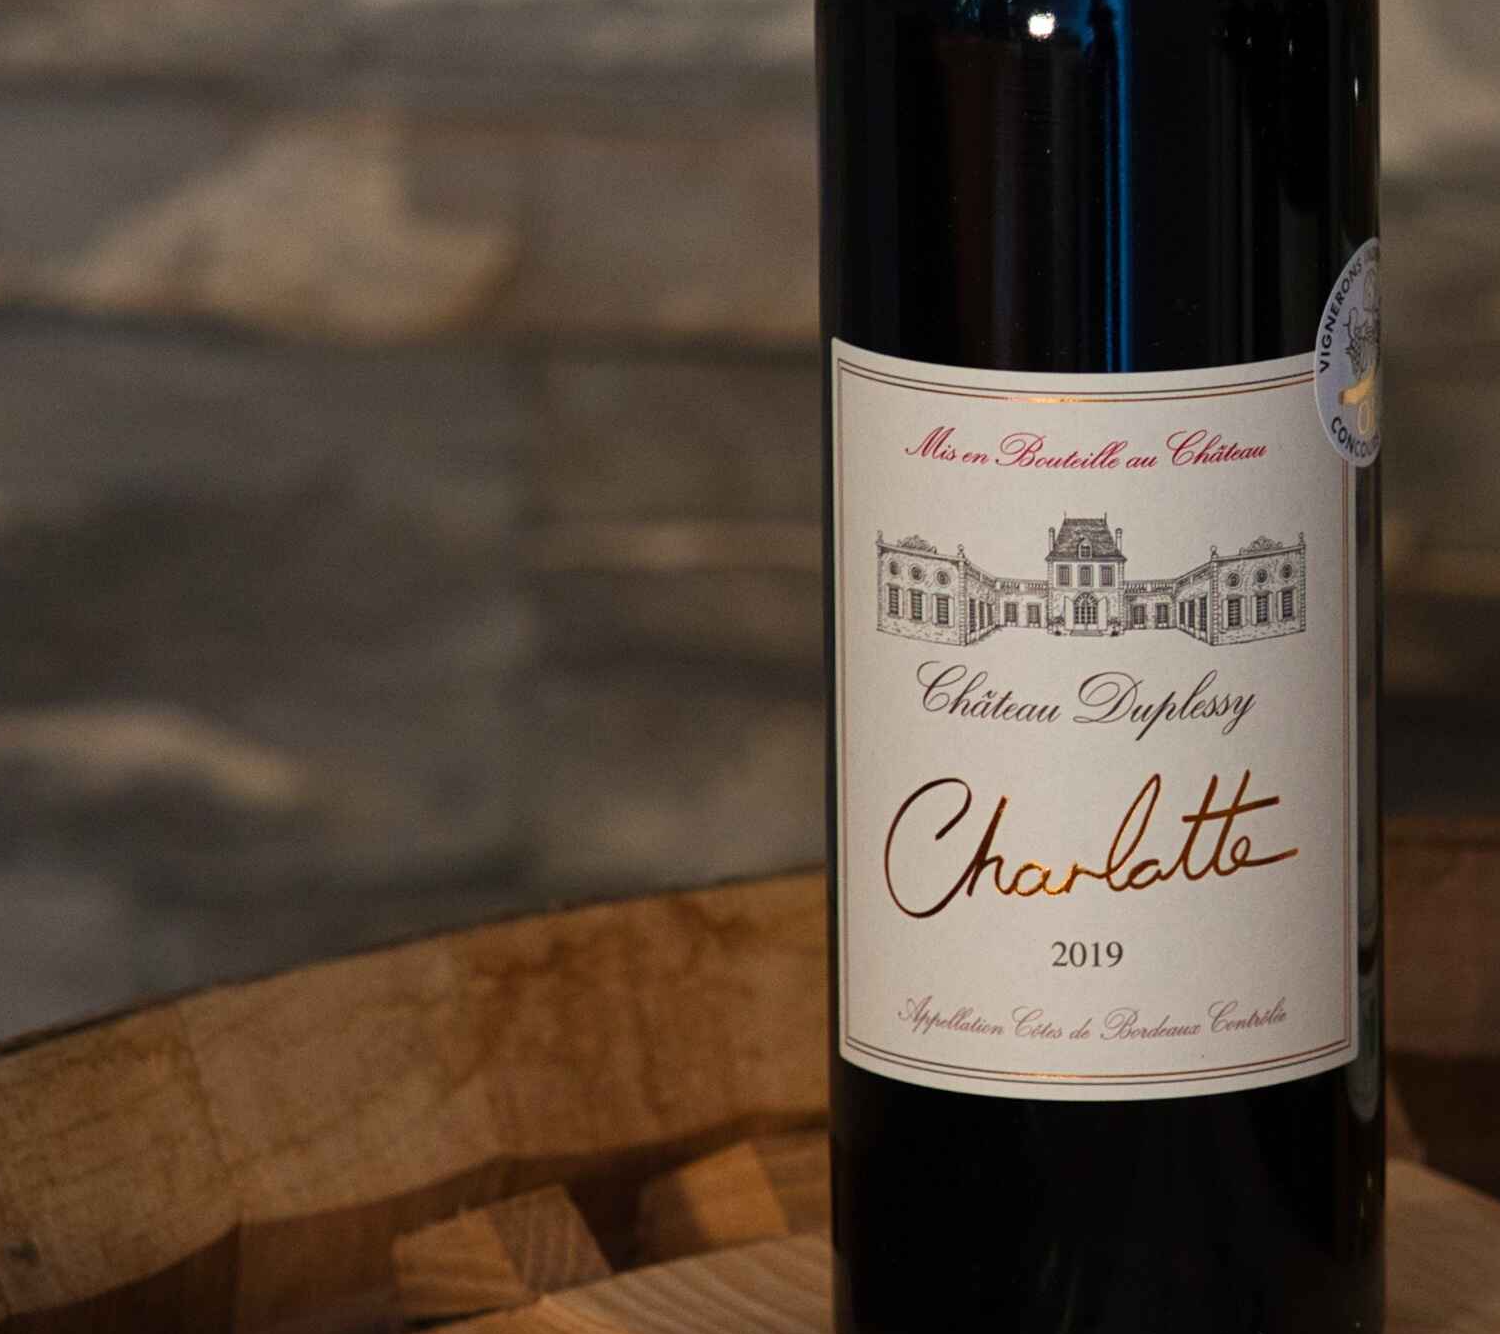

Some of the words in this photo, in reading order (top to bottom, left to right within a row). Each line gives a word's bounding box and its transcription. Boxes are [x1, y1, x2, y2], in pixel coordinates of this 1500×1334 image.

[905, 426, 954, 460] Mis
[961, 450, 990, 466] en
[995, 431, 1128, 469] Bouteille
[1125, 451, 1157, 469] au
[1165, 429, 1269, 467] Château
[916, 660, 1061, 723] Château
[1073, 669, 1257, 742] Duplessy
[1050, 941, 1125, 969] 2019
[897, 995, 1006, 1036] Appellation
[1011, 1004, 1062, 1041] Côtes
[1069, 1018, 1092, 1041] de
[1100, 1007, 1202, 1041] Bordeaux
